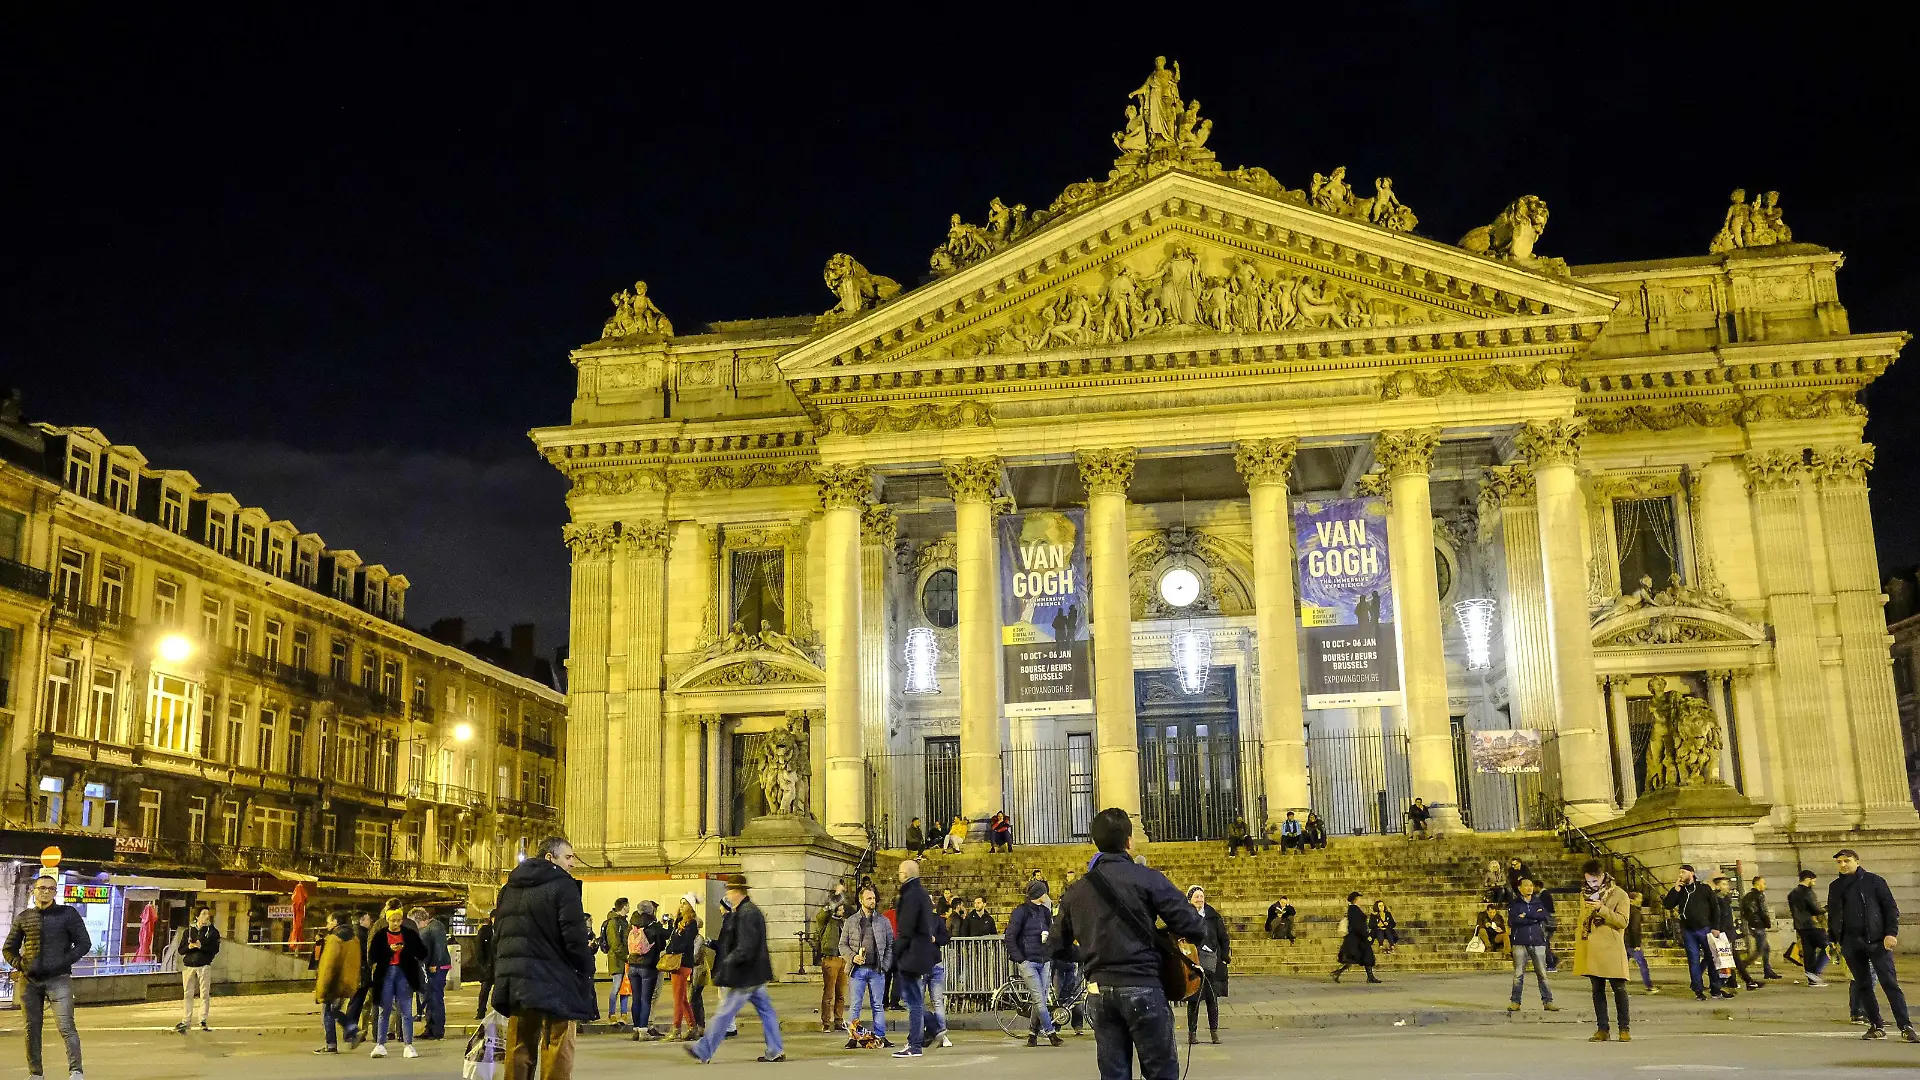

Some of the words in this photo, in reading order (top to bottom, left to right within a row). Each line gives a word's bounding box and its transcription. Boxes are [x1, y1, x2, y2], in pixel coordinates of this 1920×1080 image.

[1315, 519, 1367, 547] VAN
[1020, 544, 1064, 570] VAN
[1308, 547, 1378, 578] GOGH
[1012, 569, 1074, 598] GOGH
[1321, 640, 1331, 649] 10
[1332, 639, 1345, 648] OCT
[1352, 639, 1361, 647] 06
[1362, 638, 1377, 647] JAN
[1020, 652, 1029, 661] 10
[1029, 651, 1043, 660] OCT
[1048, 651, 1058, 659] 06
[1058, 650, 1072, 659] JAN
[1322, 652, 1350, 662] BOURSE
[1354, 651, 1378, 660] BEURS
[1020, 664, 1046, 674] BOURSE
[1050, 663, 1072, 672] BEURS
[1332, 660, 1368, 670] BRUSSELS
[1029, 672, 1063, 681] BRUSSELS
[1324, 673, 1380, 684] EXPOVANGOGH.BE
[1021, 684, 1073, 696] EXPOVANGOGH.BE
